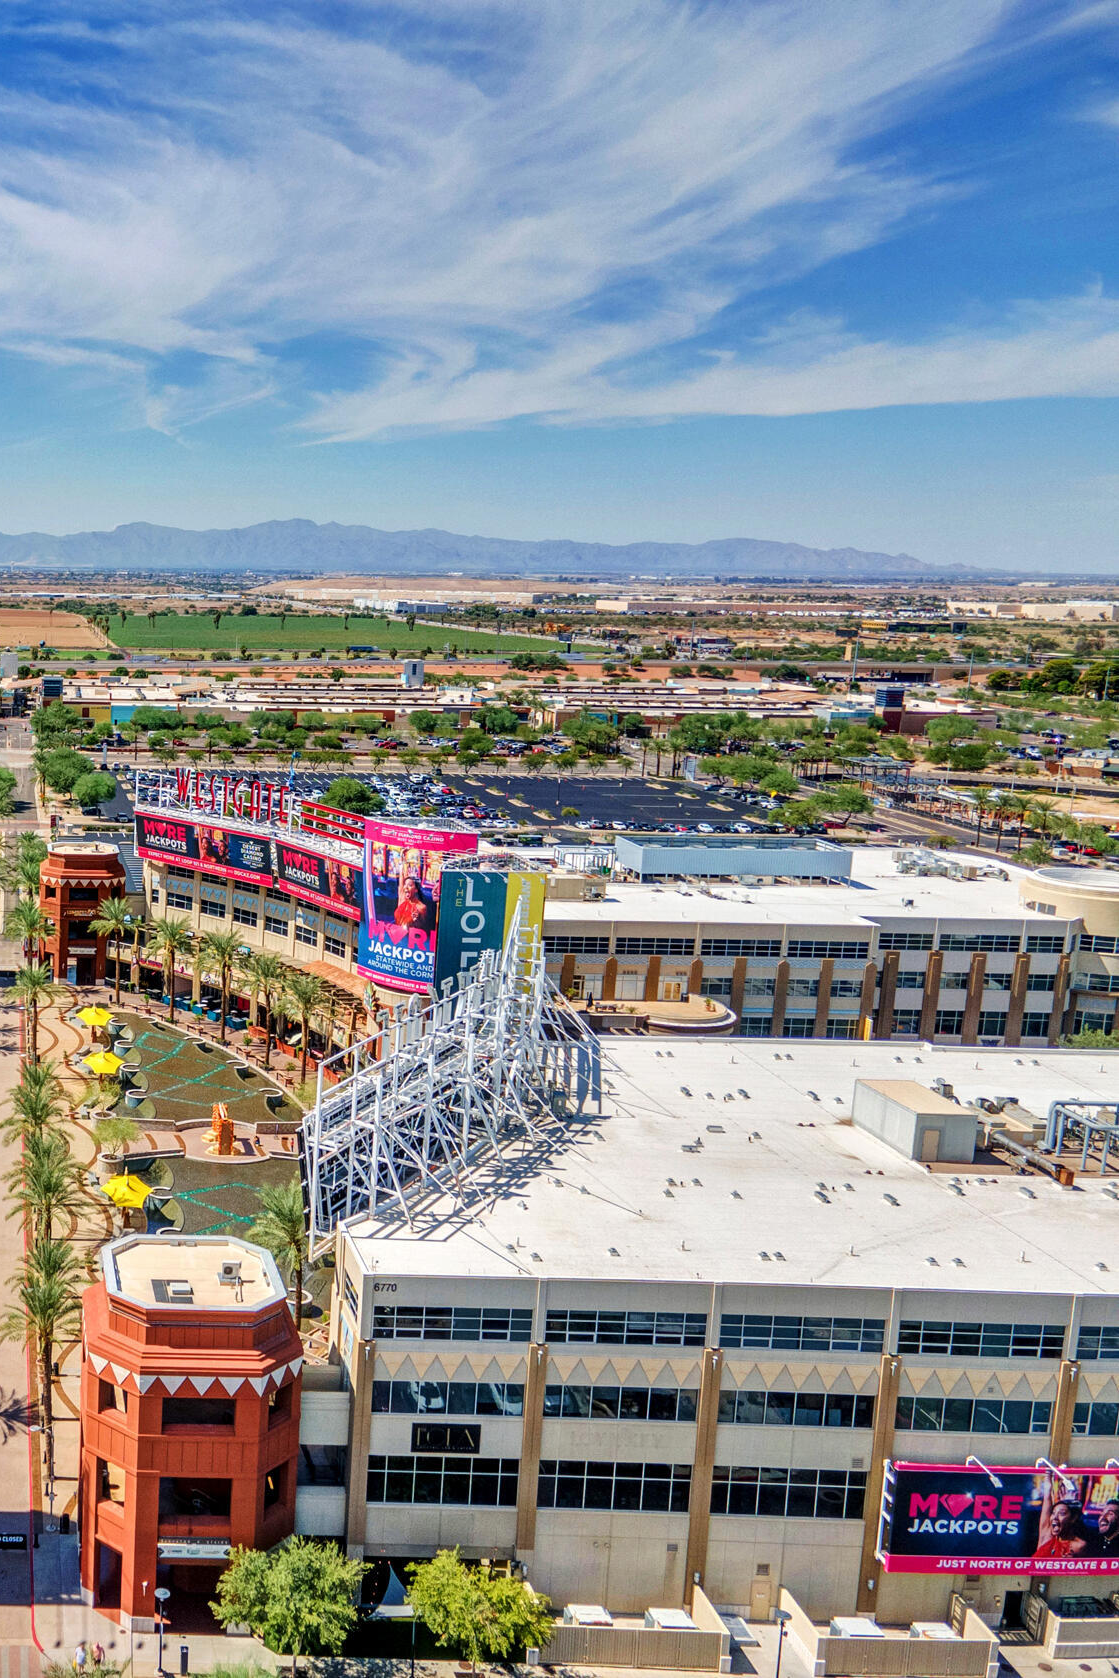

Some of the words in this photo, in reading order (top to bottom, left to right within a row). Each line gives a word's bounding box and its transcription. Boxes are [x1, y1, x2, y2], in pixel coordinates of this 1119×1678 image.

[176, 768, 289, 823] WESTGATE
[145, 834, 187, 850] JACKPOTS
[243, 853, 262, 862] CASINO
[284, 865, 320, 886] JACKPOTS
[455, 879, 465, 907] THE
[368, 940, 435, 964] JACKPOT
[368, 960, 393, 971] AROUND
[395, 966, 408, 975] THE
[410, 970, 433, 978] CORN
[375, 955, 414, 969] STATEWIDE
[416, 964, 434, 972] AND
[373, 1283, 397, 1292] 6770
[907, 1518, 1019, 1535] JACKPOTS
[936, 1559, 966, 1569] JUST
[969, 1560, 1012, 1569] NORTH
[1014, 1561, 1031, 1569] OF
[1034, 1561, 1097, 1570] WESTGATE
[1099, 1561, 1107, 1570] &
